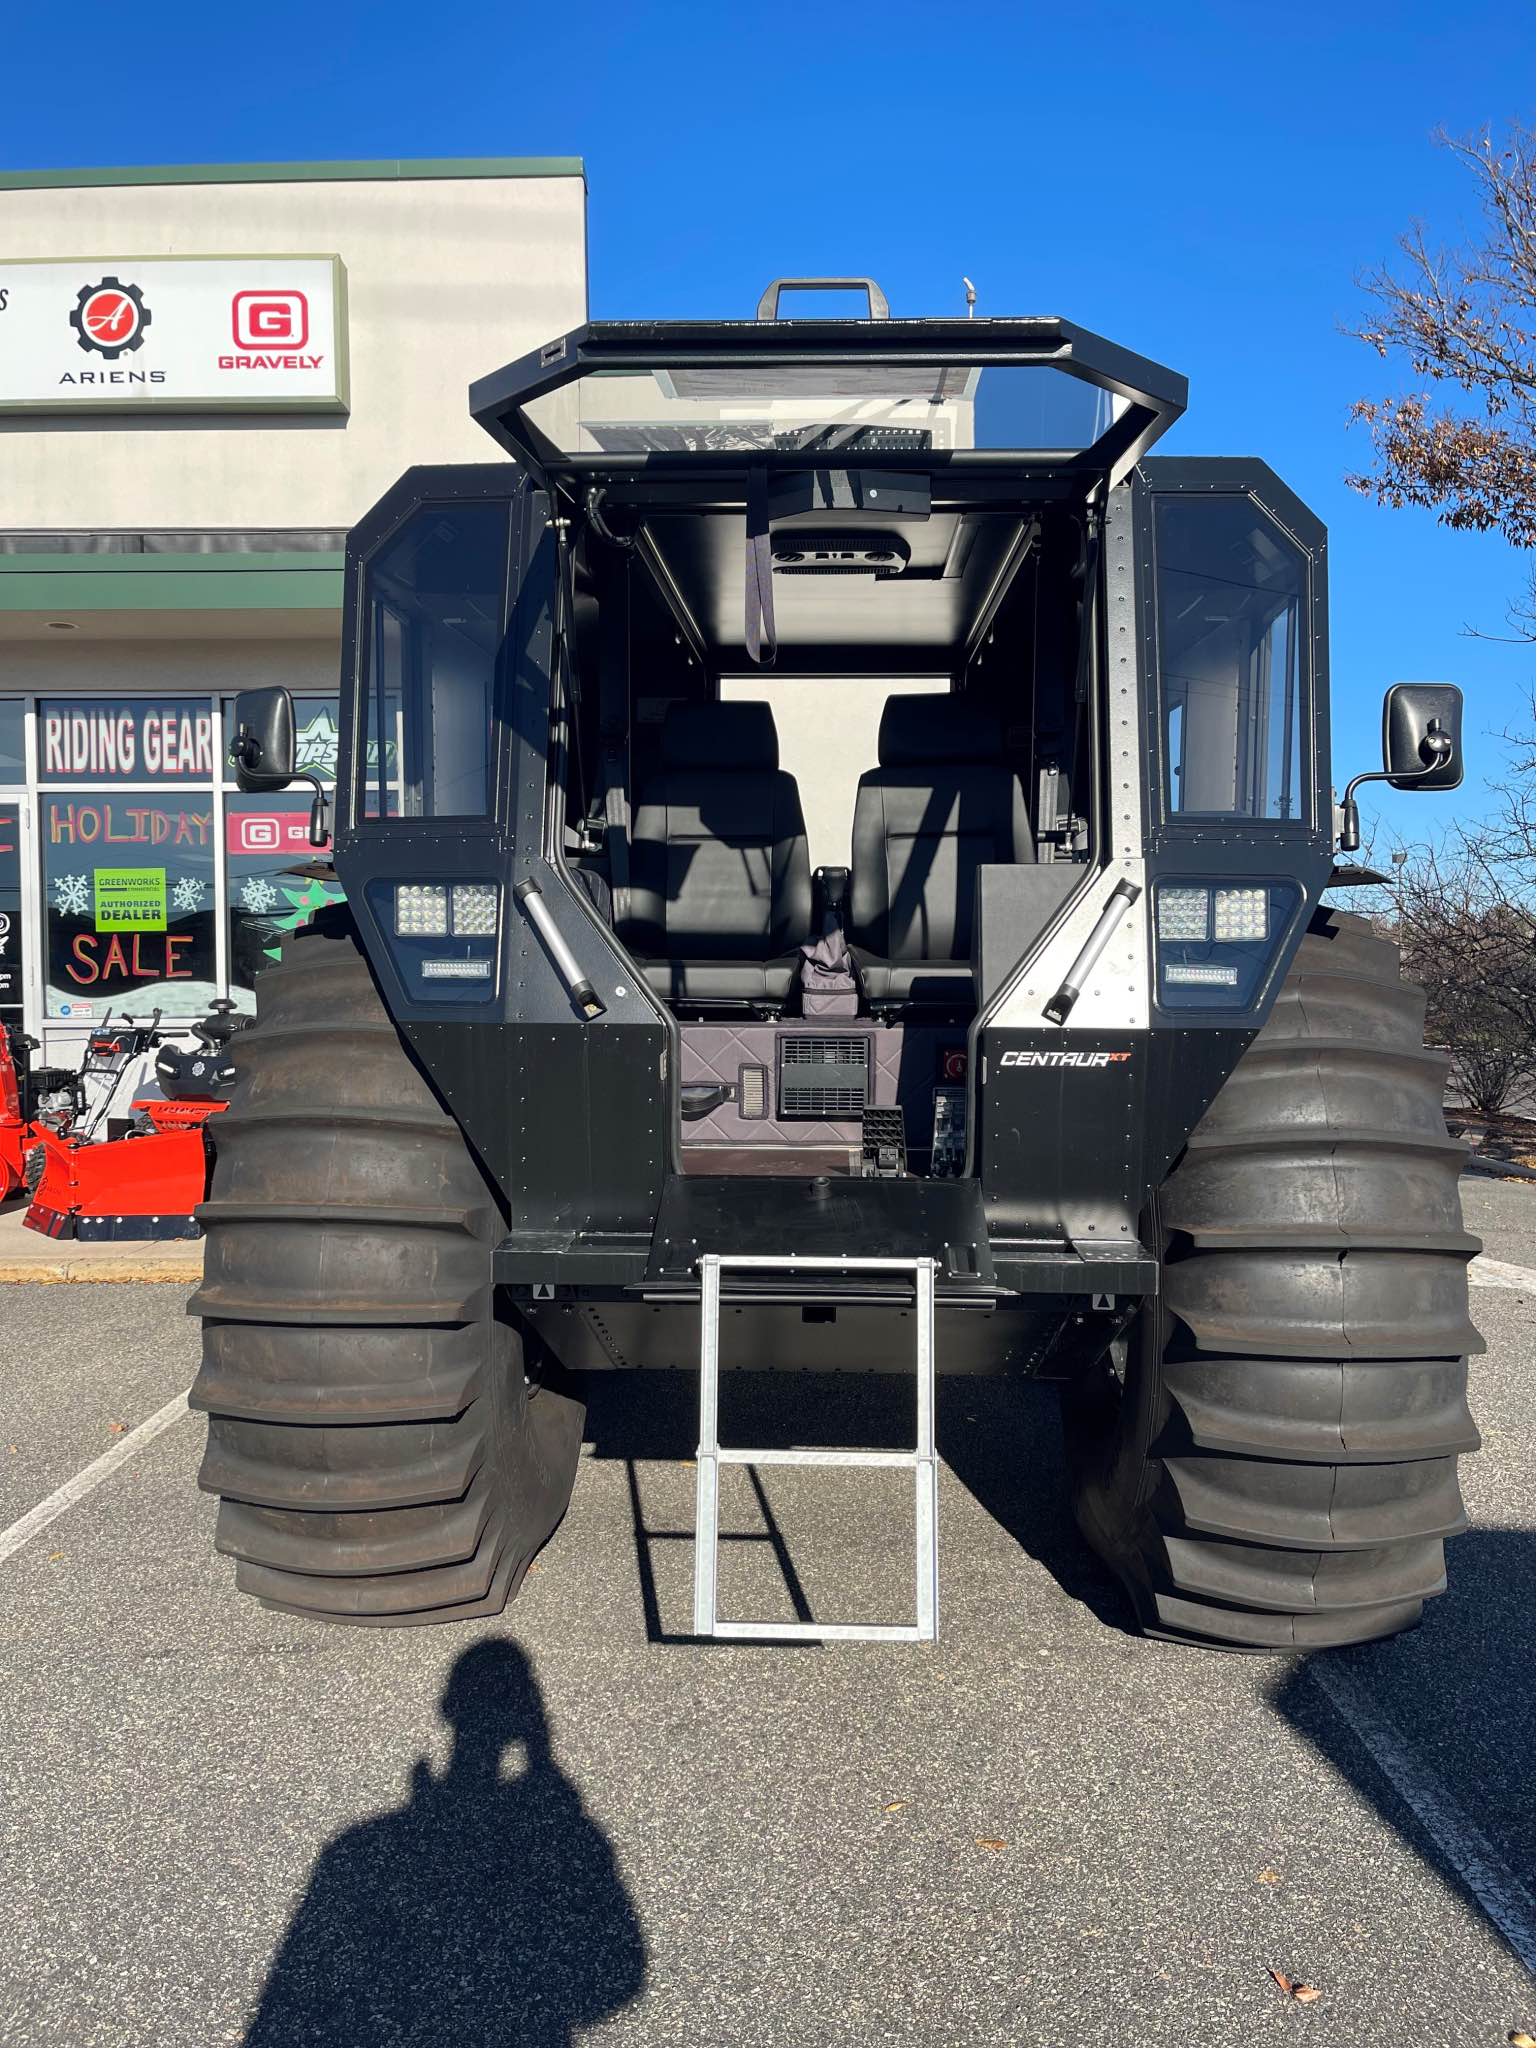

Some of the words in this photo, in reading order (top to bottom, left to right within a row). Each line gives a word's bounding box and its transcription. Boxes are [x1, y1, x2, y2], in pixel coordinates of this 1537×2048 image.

[249, 303, 292, 337] G
[218, 355, 324, 369] GRAVELY
[59, 370, 167, 385] ARIENS
[46, 709, 136, 774] RIDING
[142, 709, 213, 774] GEAR
[50, 803, 212, 846] HOLIDAY
[99, 878, 161, 886] GREENWORKS
[100, 900, 161, 908] AUTHORIZED
[101, 909, 161, 921] DEALER
[65, 933, 194, 985] SALE
